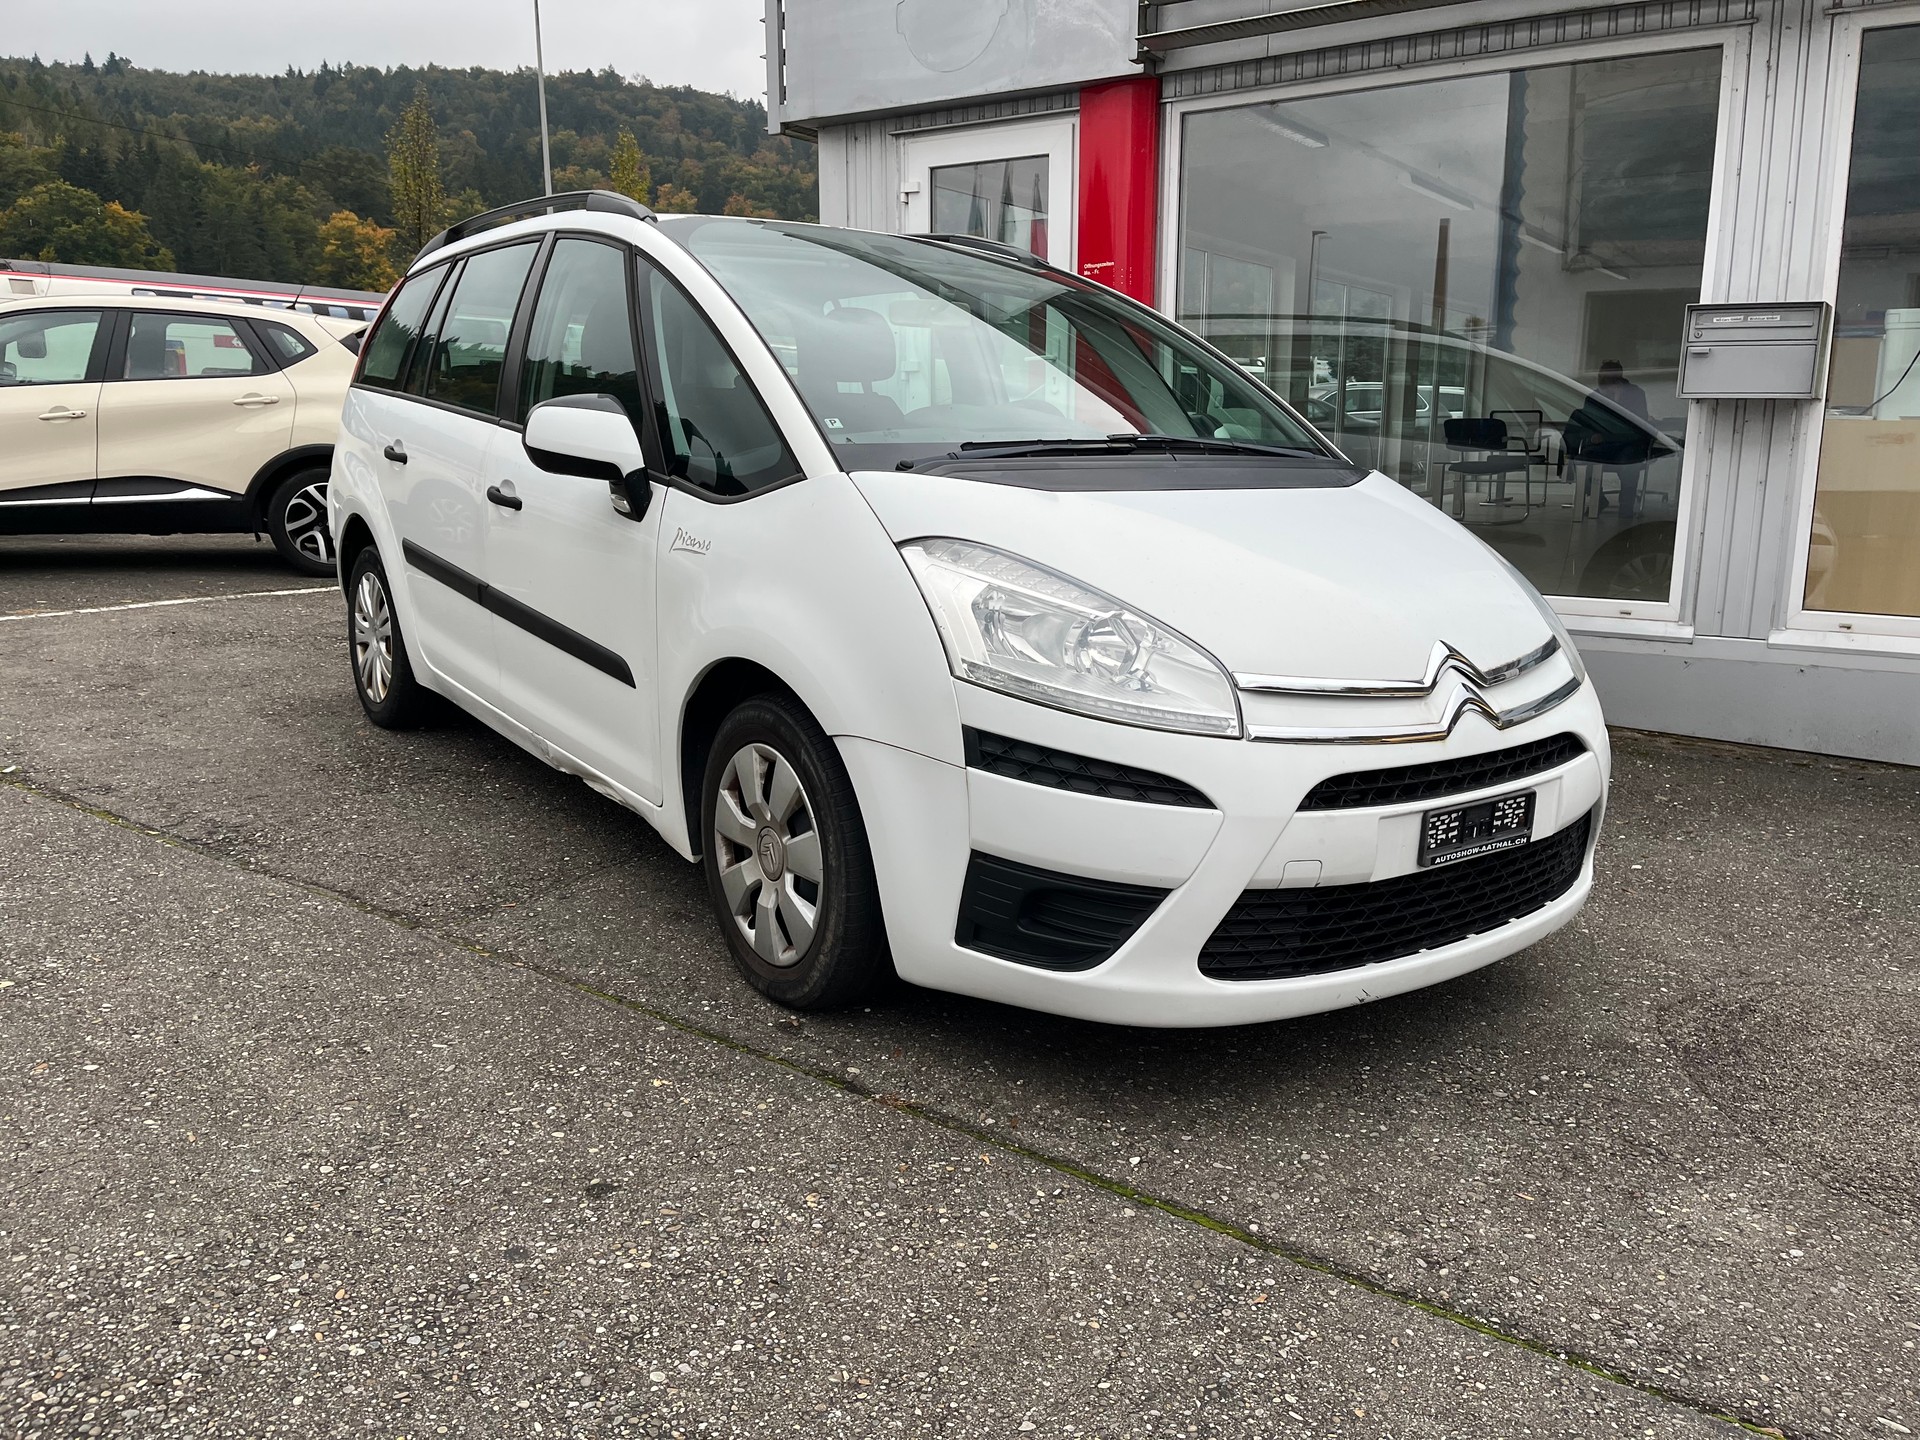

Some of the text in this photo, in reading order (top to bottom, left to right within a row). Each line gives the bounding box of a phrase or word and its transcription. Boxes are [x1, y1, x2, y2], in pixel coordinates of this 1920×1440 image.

[828, 419, 837, 427] P
[668, 527, 712, 555] Picasso
[1434, 837, 1528, 864] AUTOSHOW-AATHAL.CH
